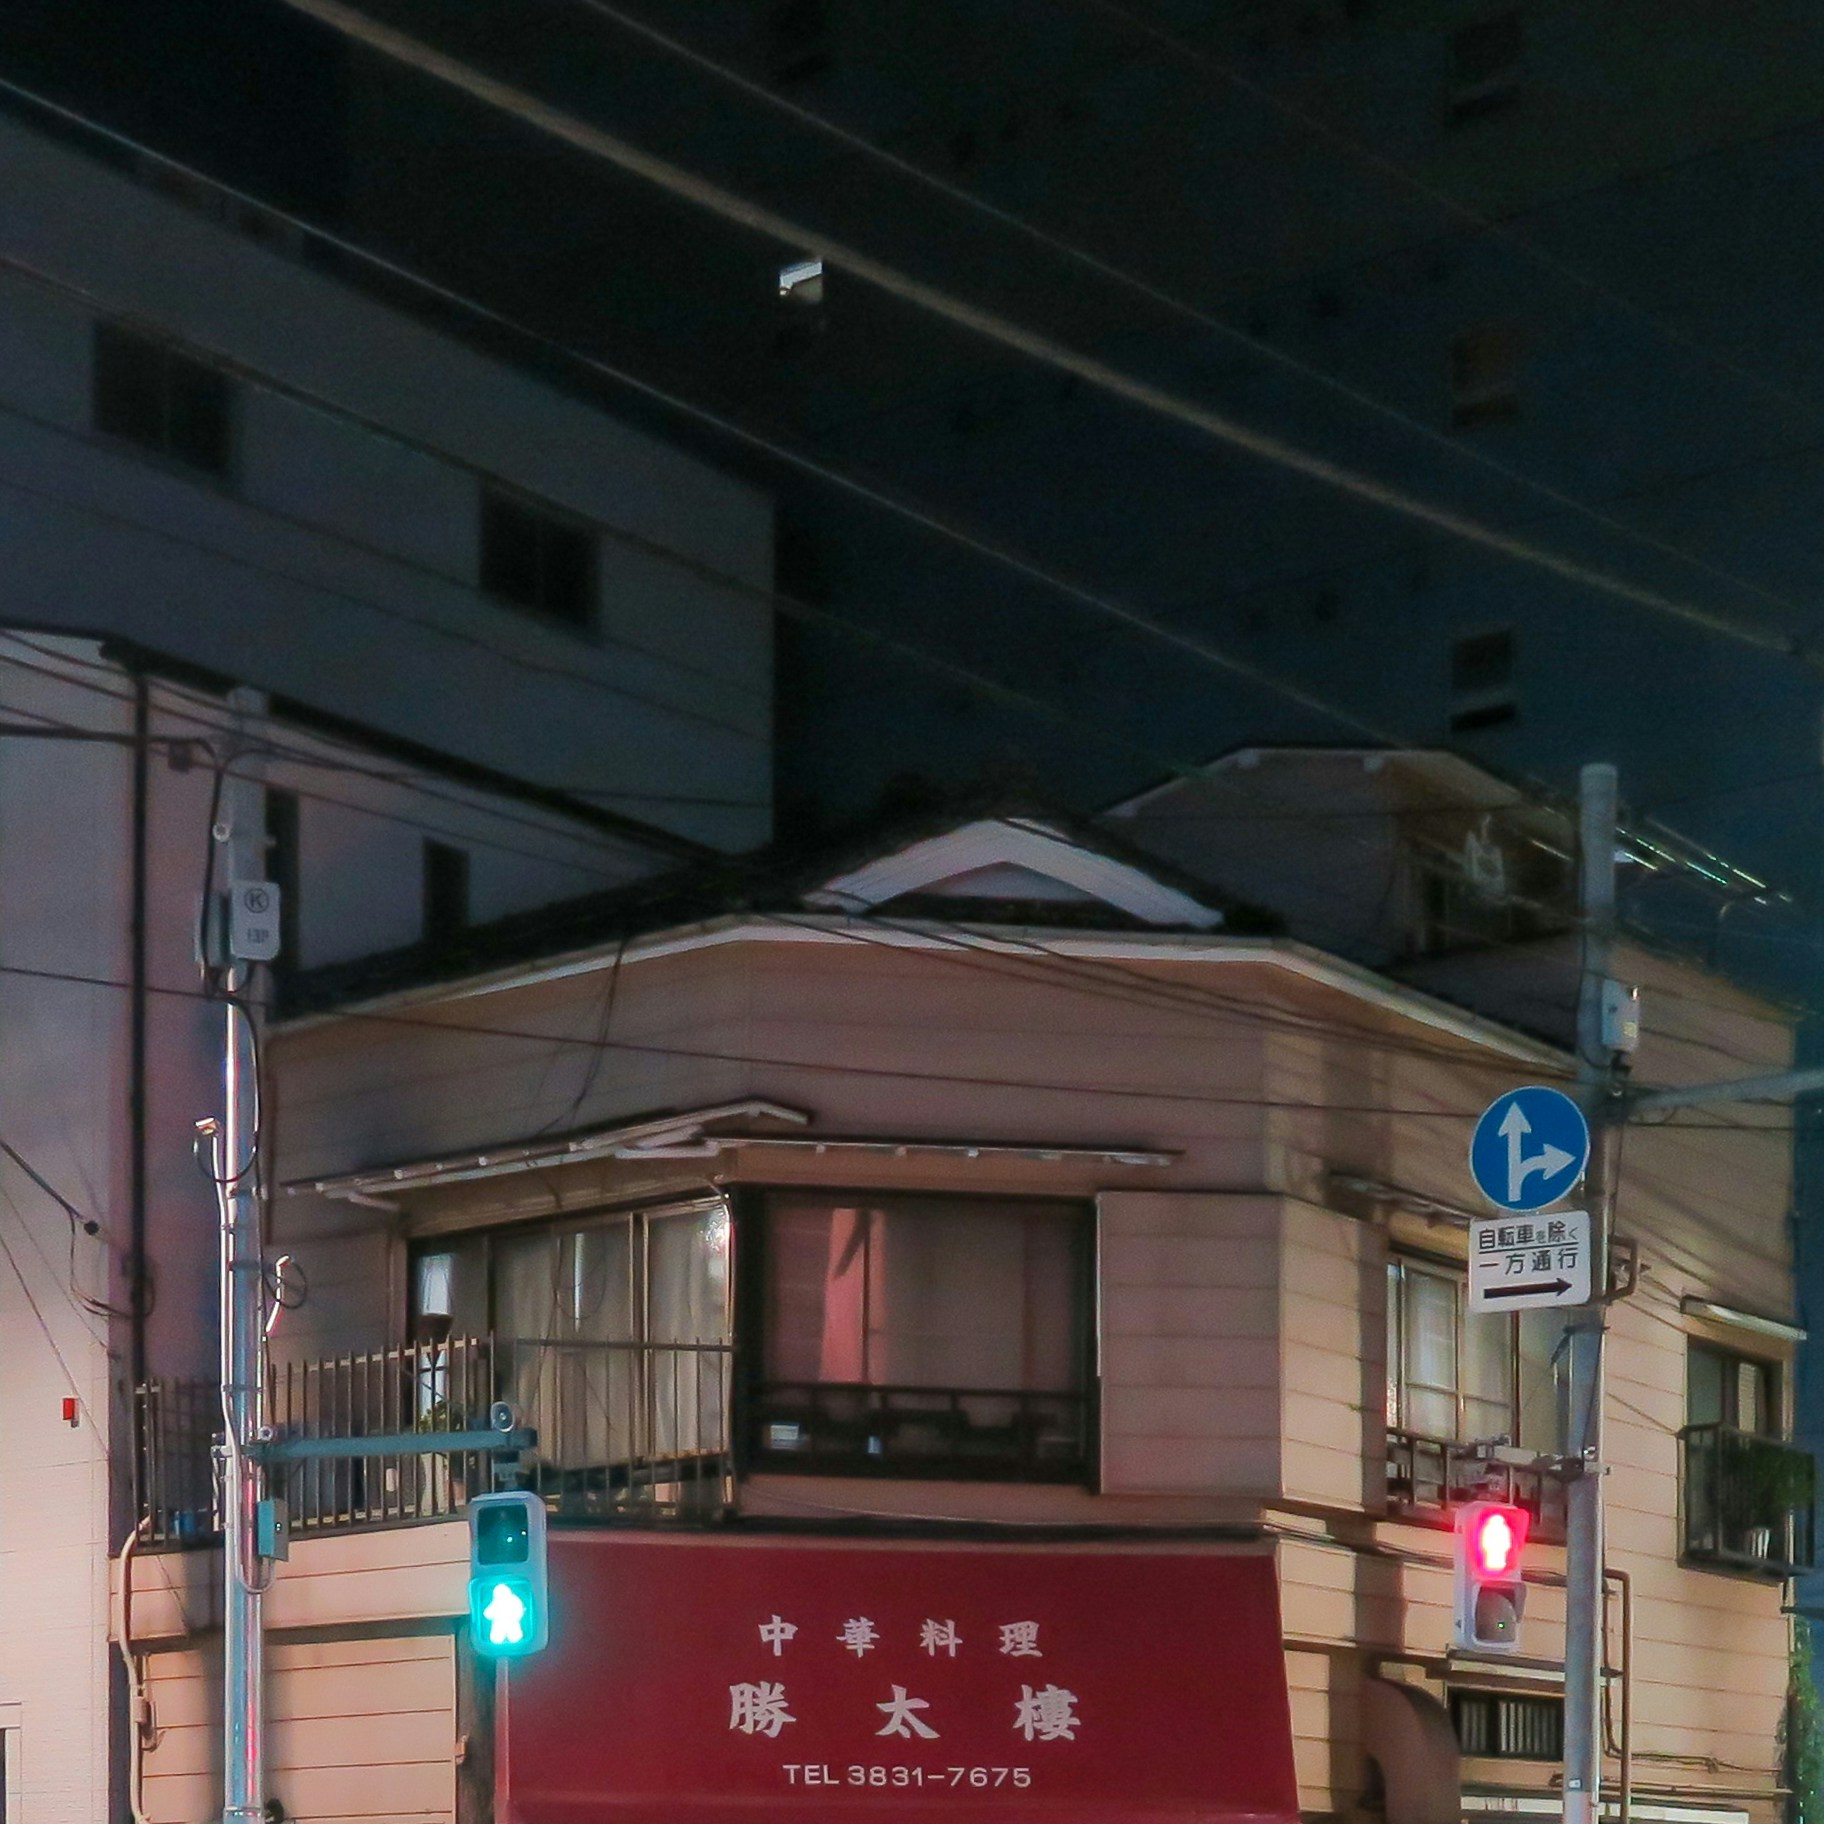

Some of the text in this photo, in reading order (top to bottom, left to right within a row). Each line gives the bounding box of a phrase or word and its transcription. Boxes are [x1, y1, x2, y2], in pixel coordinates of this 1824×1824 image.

[1479, 1220, 1578, 1250] 自転車を除く
[1479, 1247, 1578, 1275] 一方通行
[758, 1614, 1043, 1658] 中華料理
[729, 1681, 1081, 1741] 勝太樓
[783, 1765, 1031, 1788] TEL 3831-7675
